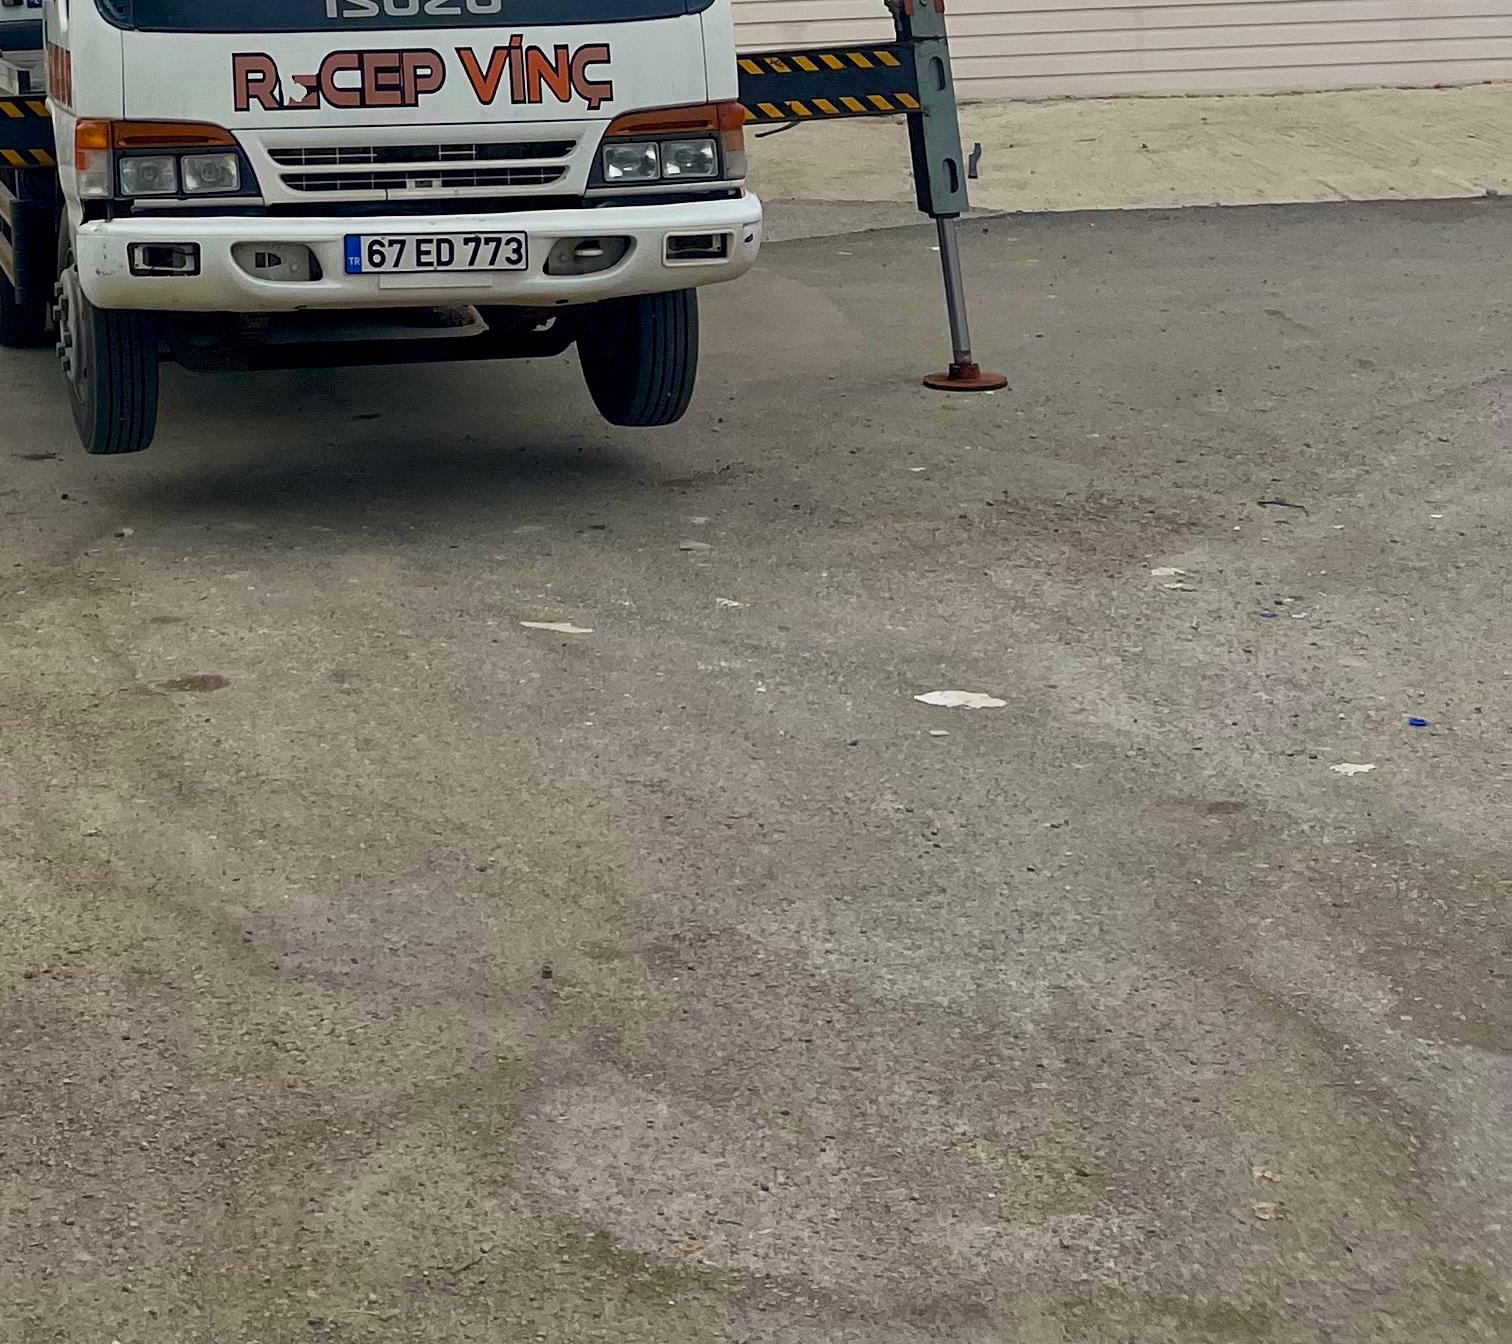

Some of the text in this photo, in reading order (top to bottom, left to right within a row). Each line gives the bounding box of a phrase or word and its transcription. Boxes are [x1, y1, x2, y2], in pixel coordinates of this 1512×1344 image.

[454, 34, 613, 111] VİNÇ
[348, 257, 360, 266] TR
[367, 236, 524, 268] 67 ED 773
